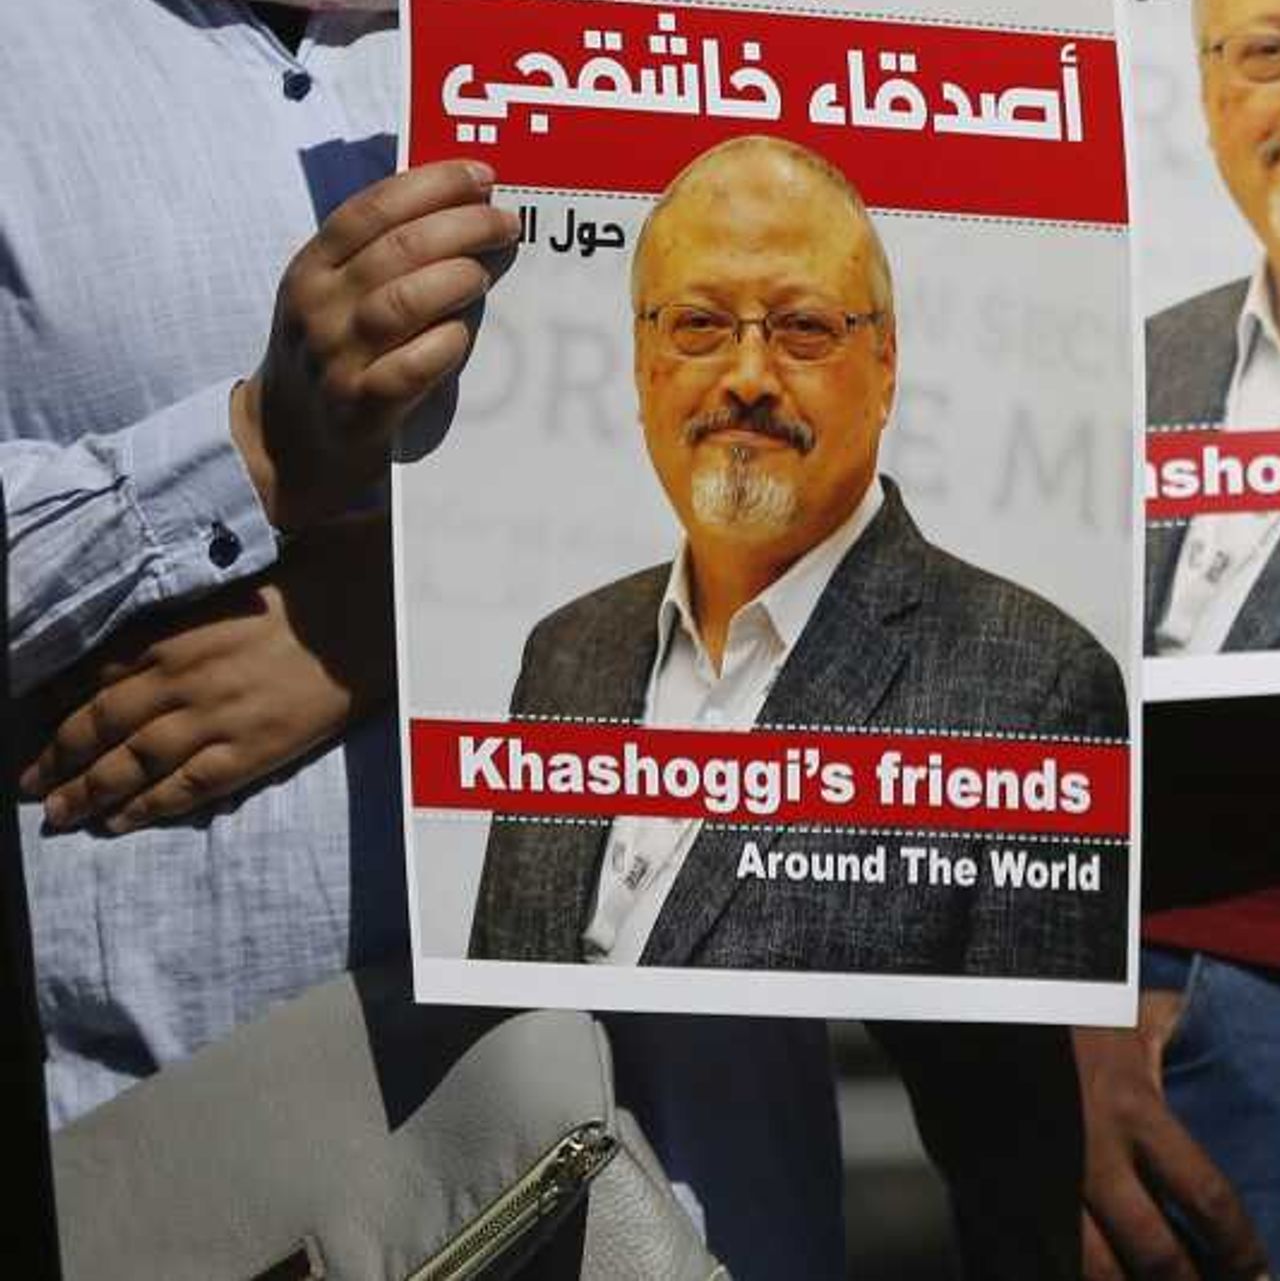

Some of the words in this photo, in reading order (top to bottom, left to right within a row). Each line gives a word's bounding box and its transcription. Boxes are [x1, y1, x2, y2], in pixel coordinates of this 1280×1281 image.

[441, 13, 782, 143] خاشقجي
[808, 42, 1084, 143] أصدقاء
[549, 208, 626, 257] حول
[457, 736, 856, 813] Khashoggi's
[875, 751, 1091, 814] friends
[736, 841, 886, 883] Around
[899, 846, 978, 887] The
[989, 849, 1100, 891] World
